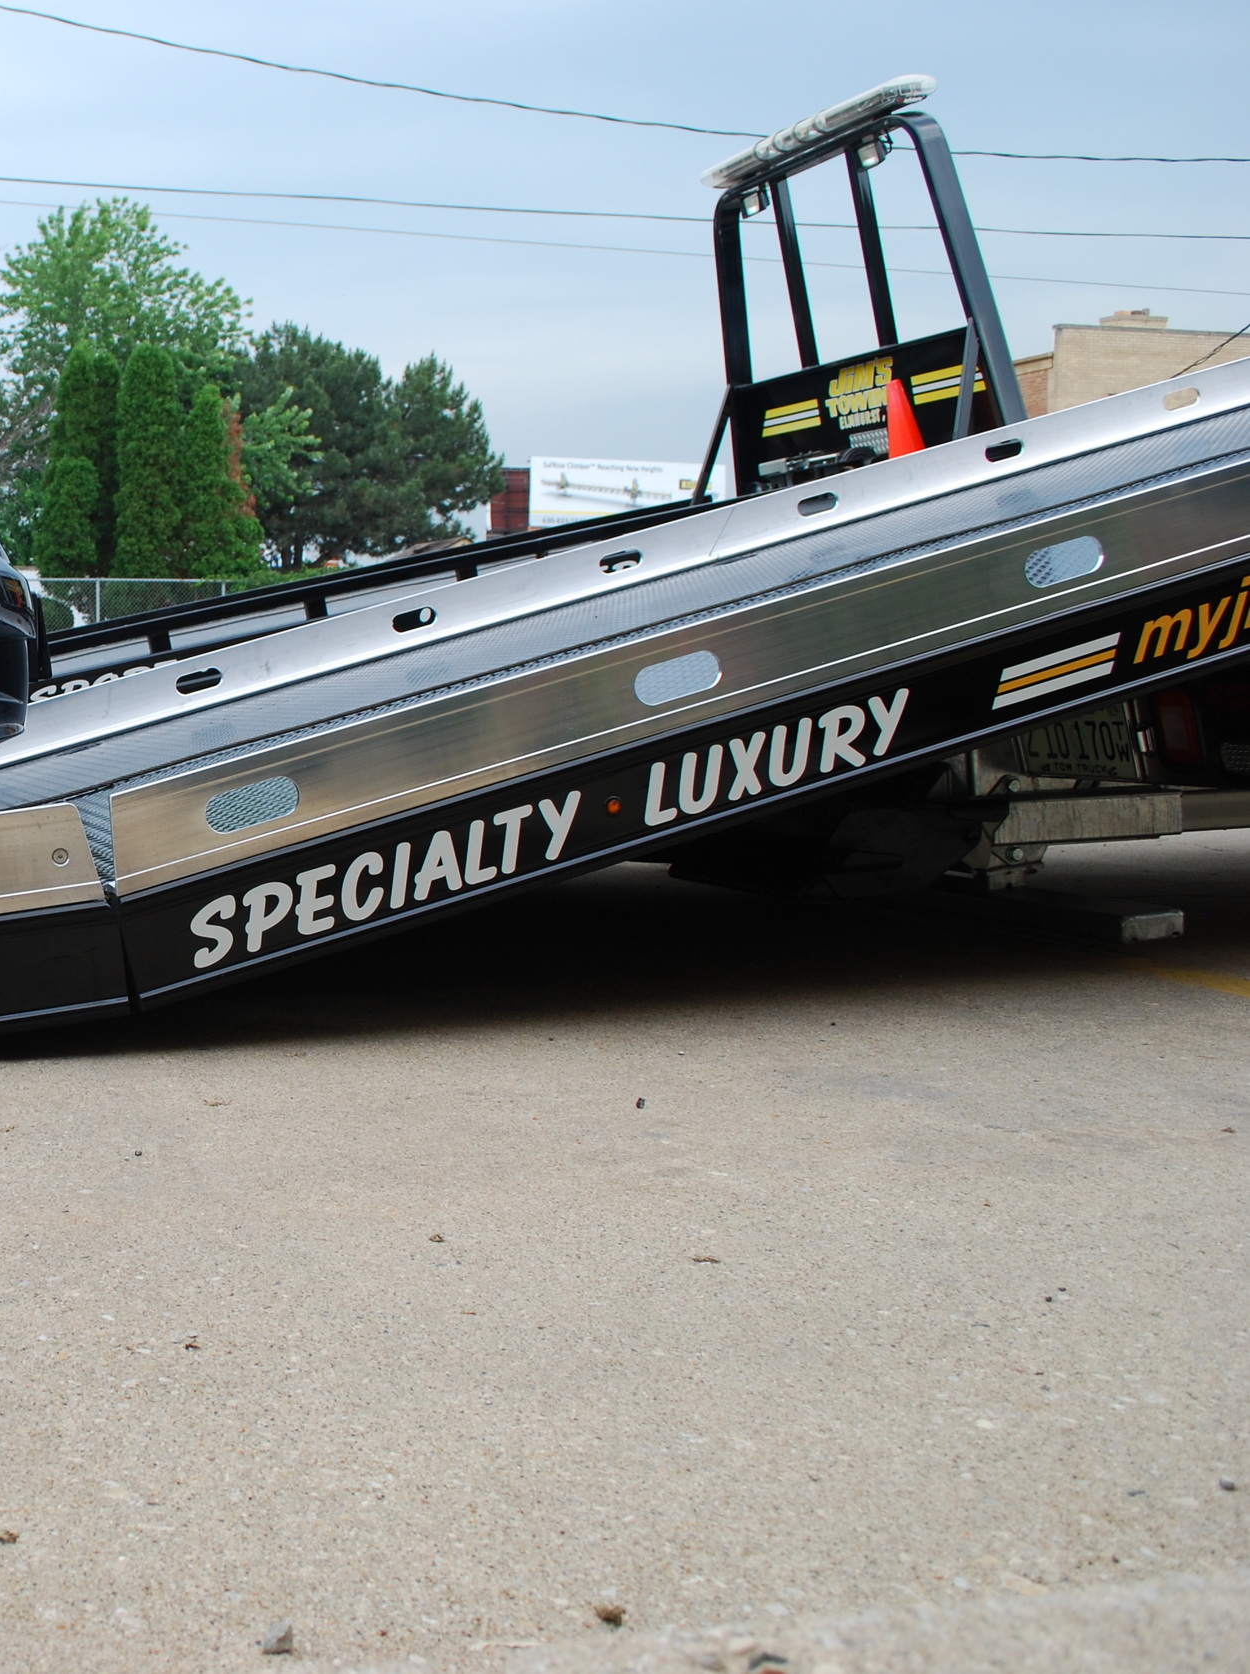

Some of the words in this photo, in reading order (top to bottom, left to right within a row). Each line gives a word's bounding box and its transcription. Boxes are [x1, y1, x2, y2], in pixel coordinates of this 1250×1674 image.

[825, 386, 888, 418] TOWIN
[626, 464, 640, 472] New
[641, 465, 663, 474] Heights
[1077, 763, 1107, 774] TRUCK
[190, 790, 581, 969] SPECIALTY
[644, 688, 910, 826] LUXURY
